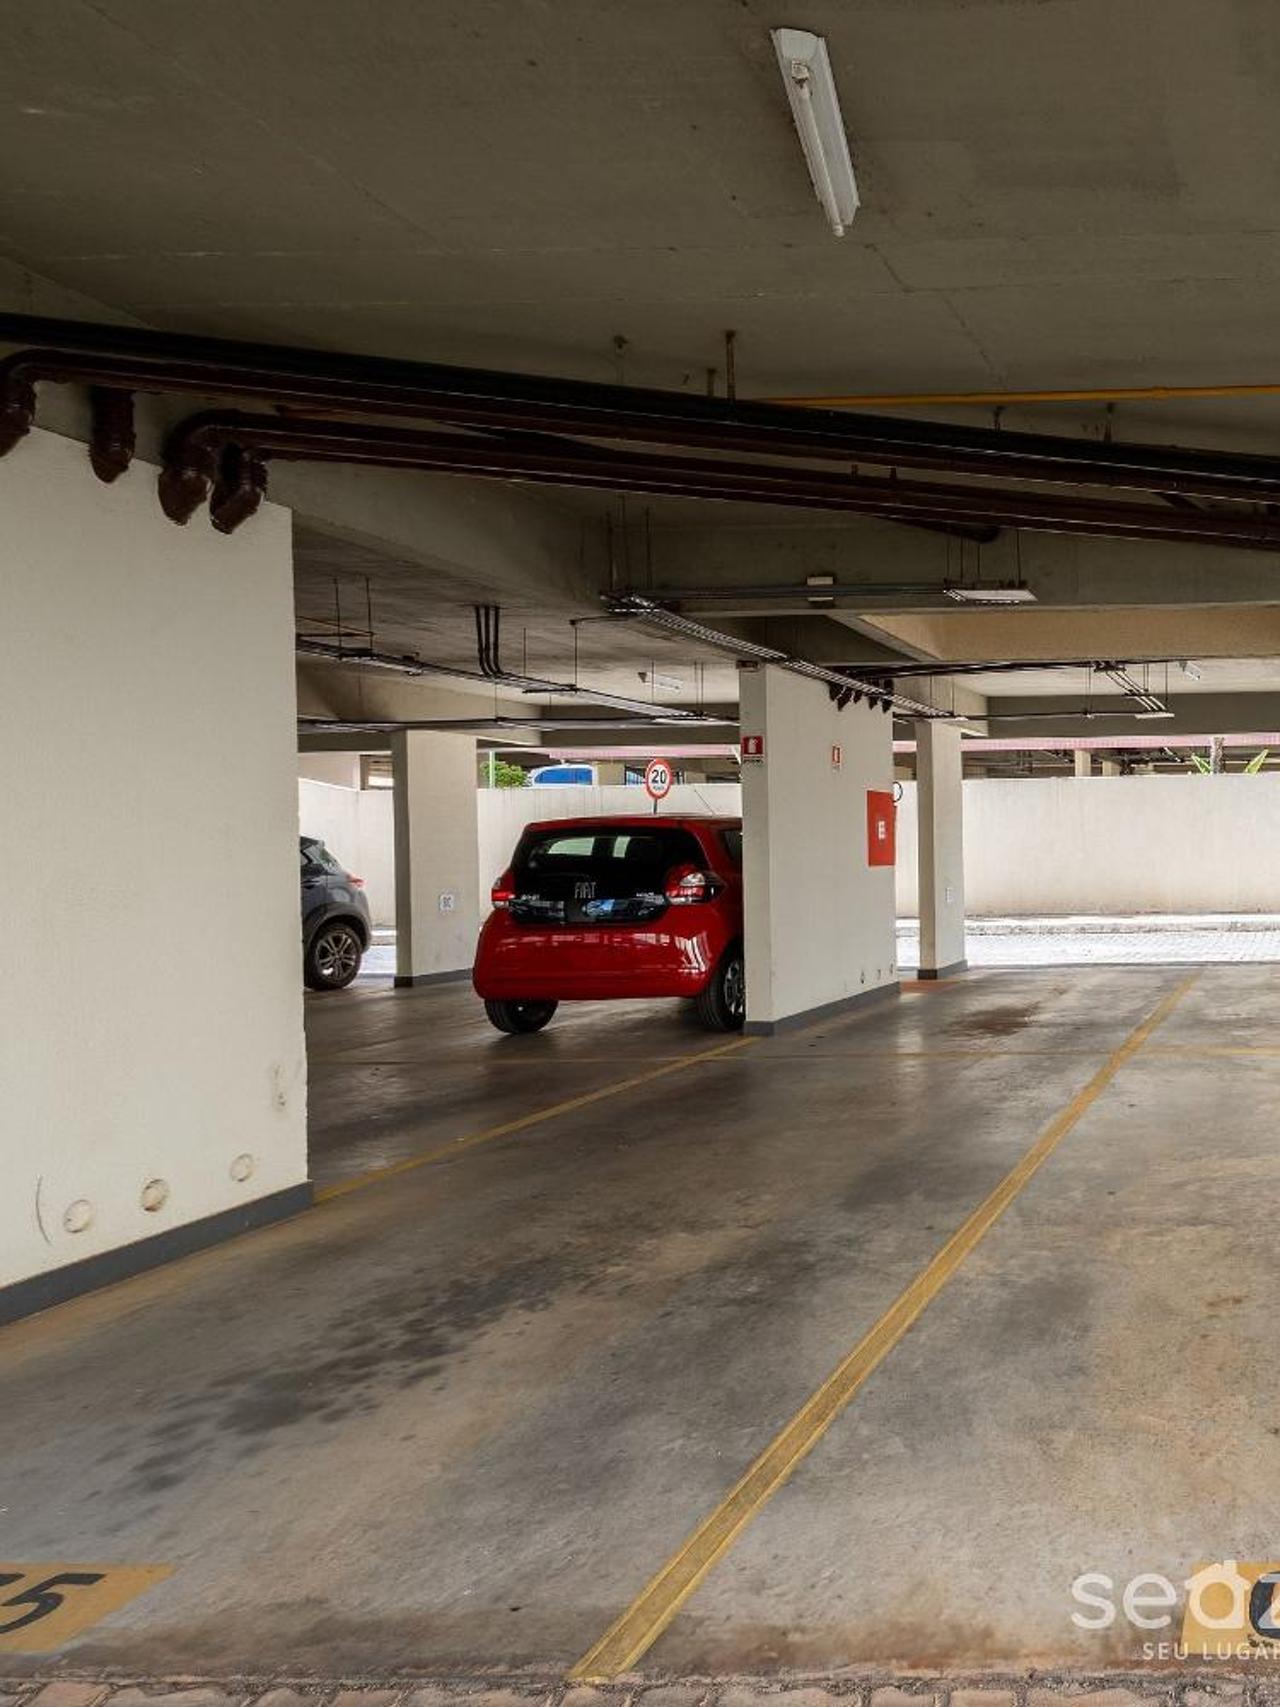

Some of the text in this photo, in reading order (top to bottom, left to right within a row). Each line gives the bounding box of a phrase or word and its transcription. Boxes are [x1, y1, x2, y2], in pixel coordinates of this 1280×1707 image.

[651, 769, 667, 784] 20
[574, 881, 597, 899] FIAT
[0, 1573, 107, 1634] 5
